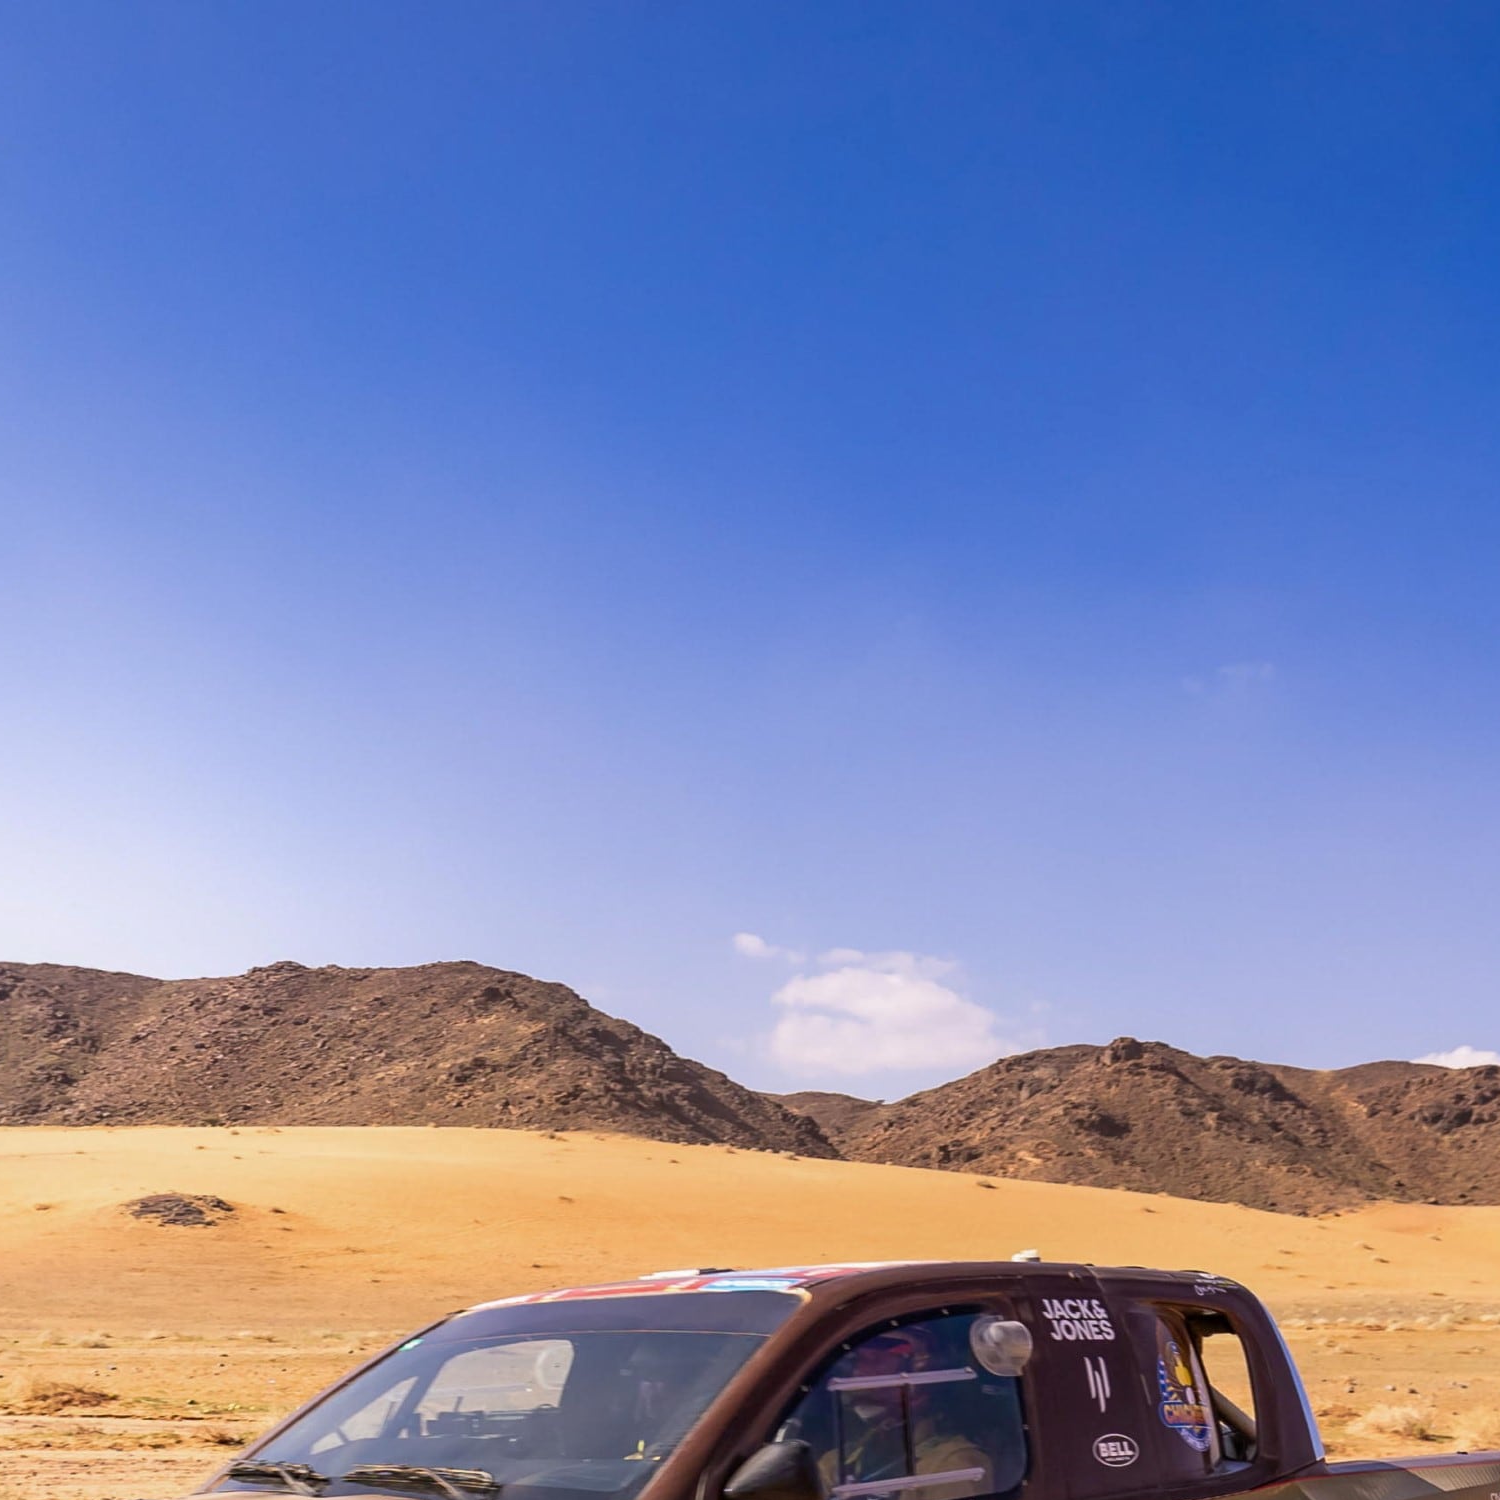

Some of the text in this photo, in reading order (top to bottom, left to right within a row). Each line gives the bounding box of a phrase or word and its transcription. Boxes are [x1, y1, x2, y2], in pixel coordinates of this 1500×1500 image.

[1042, 1299, 1108, 1320] JACK&
[1051, 1319, 1116, 1341] JONES
[1098, 1441, 1135, 1458] BELL
